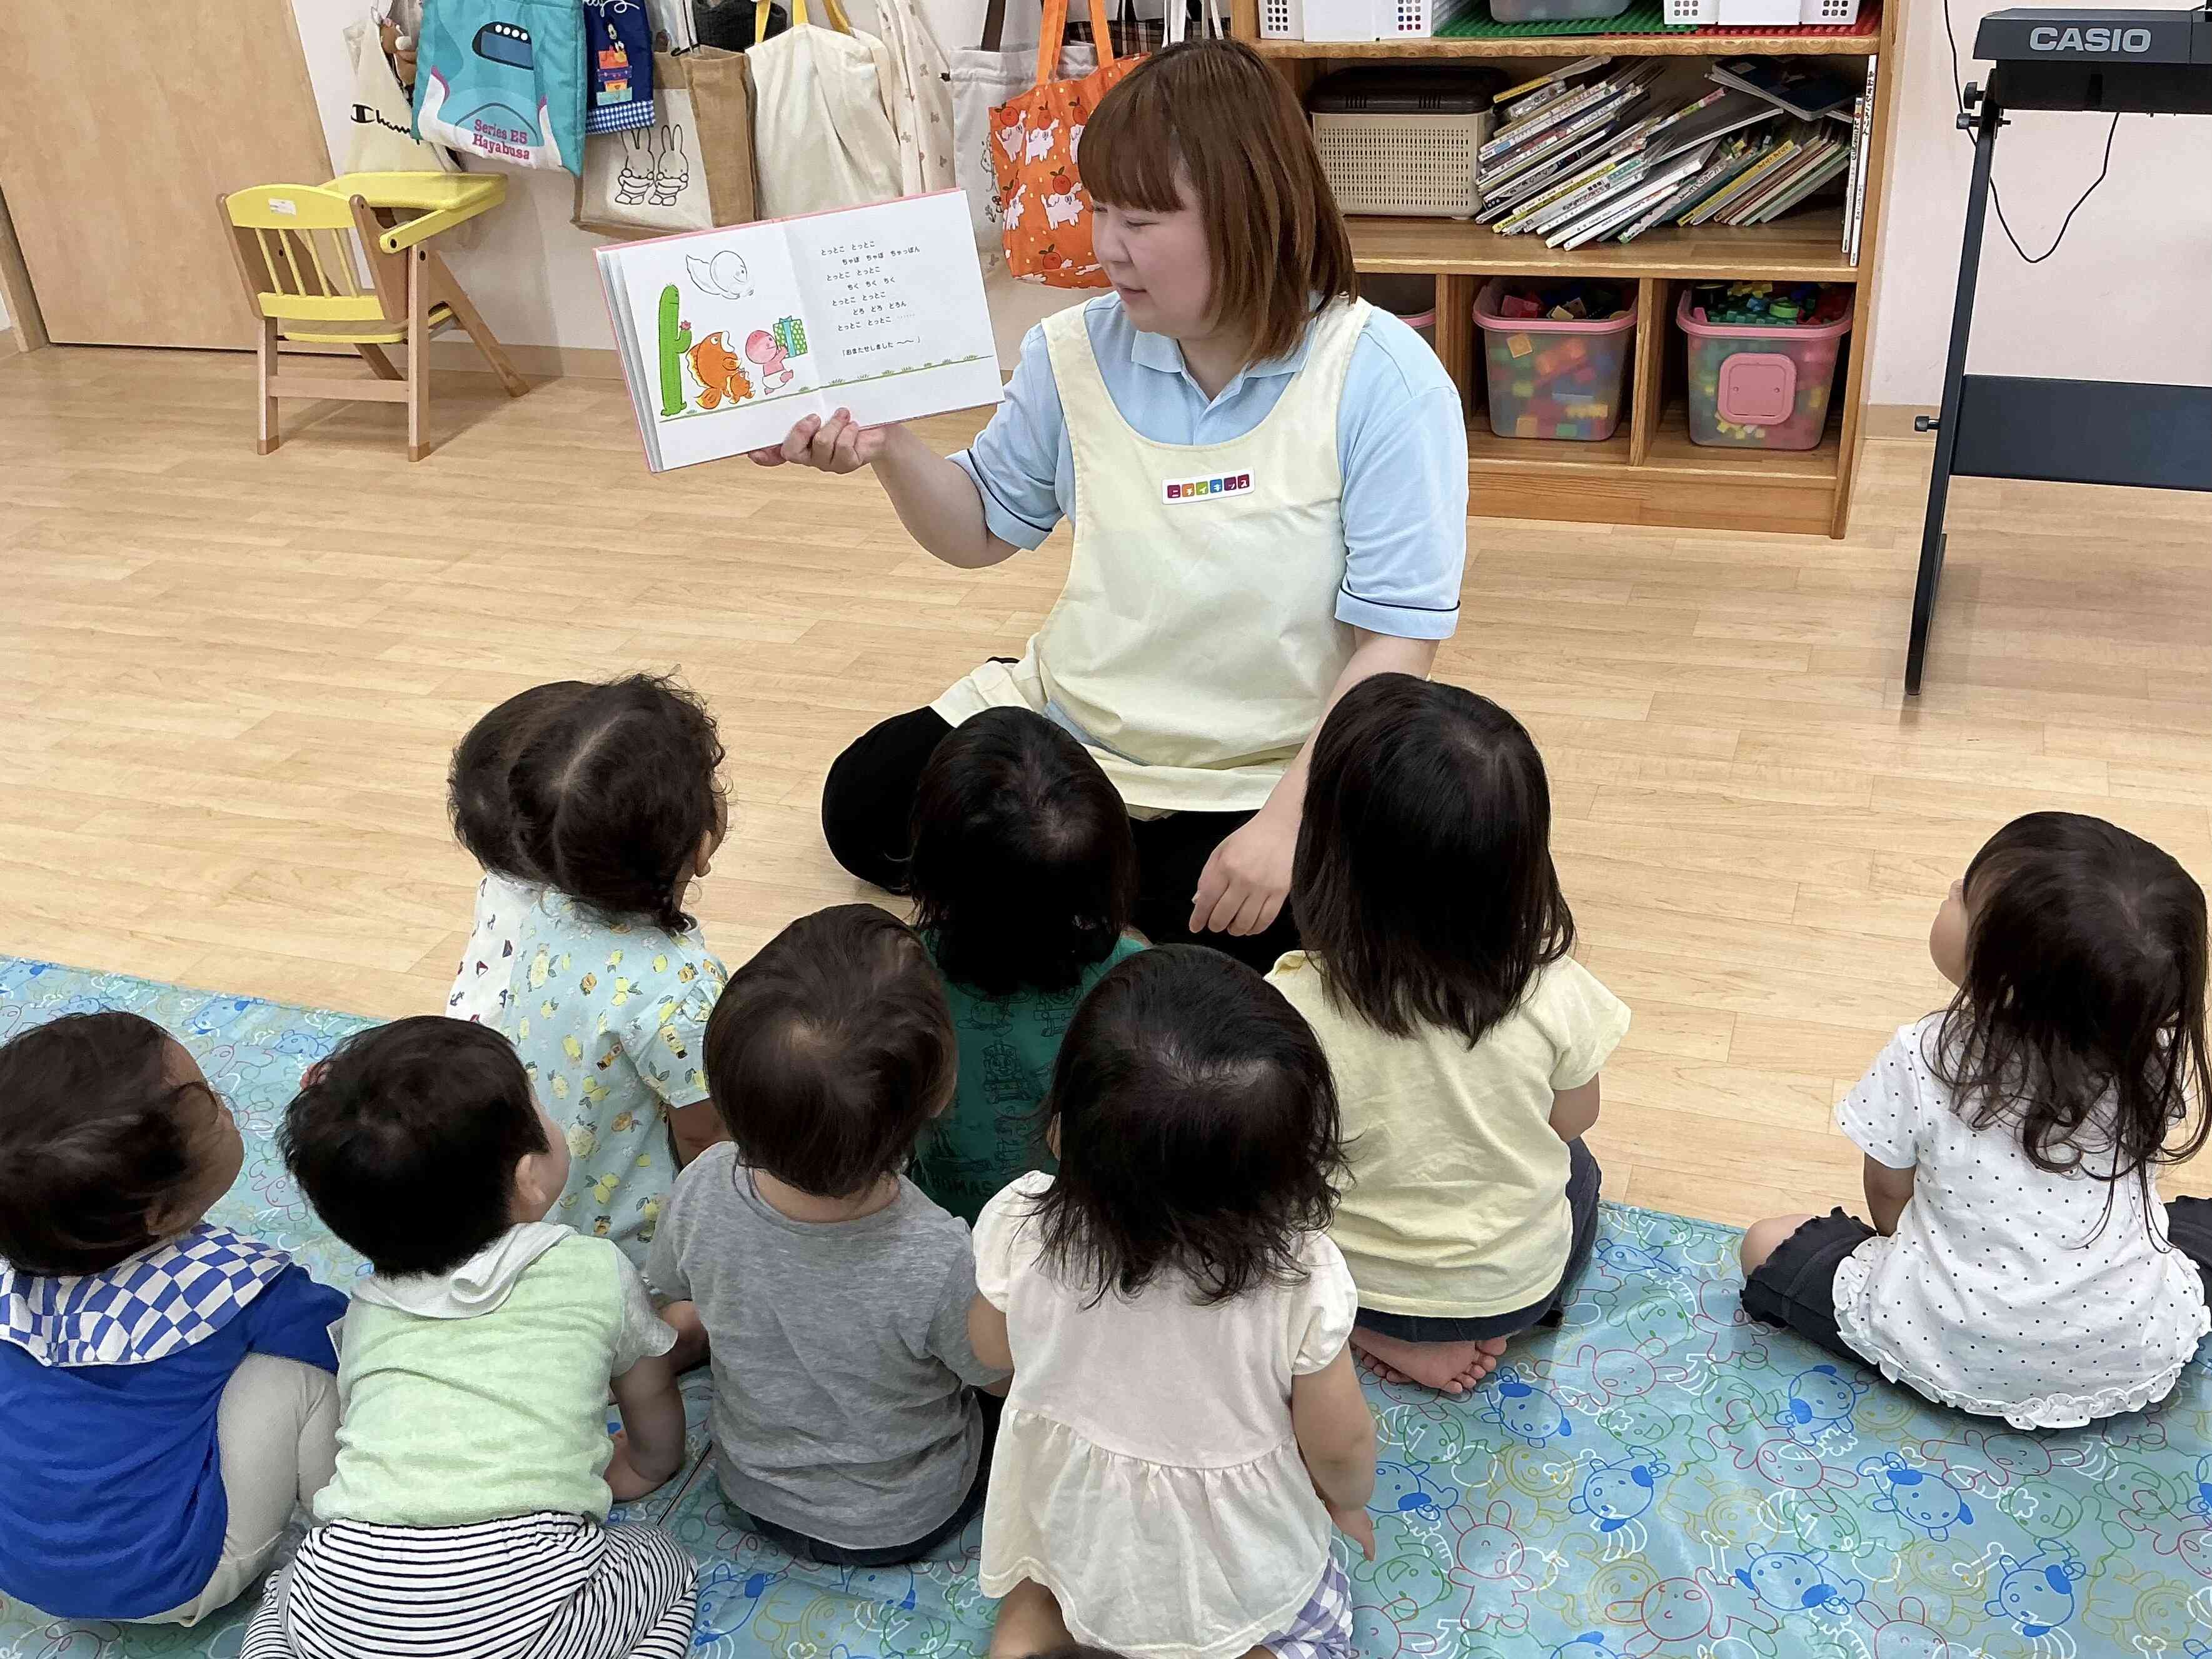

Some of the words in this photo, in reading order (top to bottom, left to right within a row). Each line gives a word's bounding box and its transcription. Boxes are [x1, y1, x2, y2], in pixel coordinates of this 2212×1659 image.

[2029, 27, 2151, 53] CASIO
[474, 119, 507, 140] Series
[511, 129, 528, 144] E5
[472, 133, 530, 159] Hayabusa
[821, 246, 845, 256] とっとこ
[852, 241, 875, 251] とっとこ
[827, 271, 851, 281] とっとこ
[857, 266, 880, 276] とっとこ
[832, 297, 856, 306] とっとこ
[862, 291, 886, 301] とっとこ
[838, 322, 862, 331] とっとこ
[868, 316, 892, 326] とっとこ
